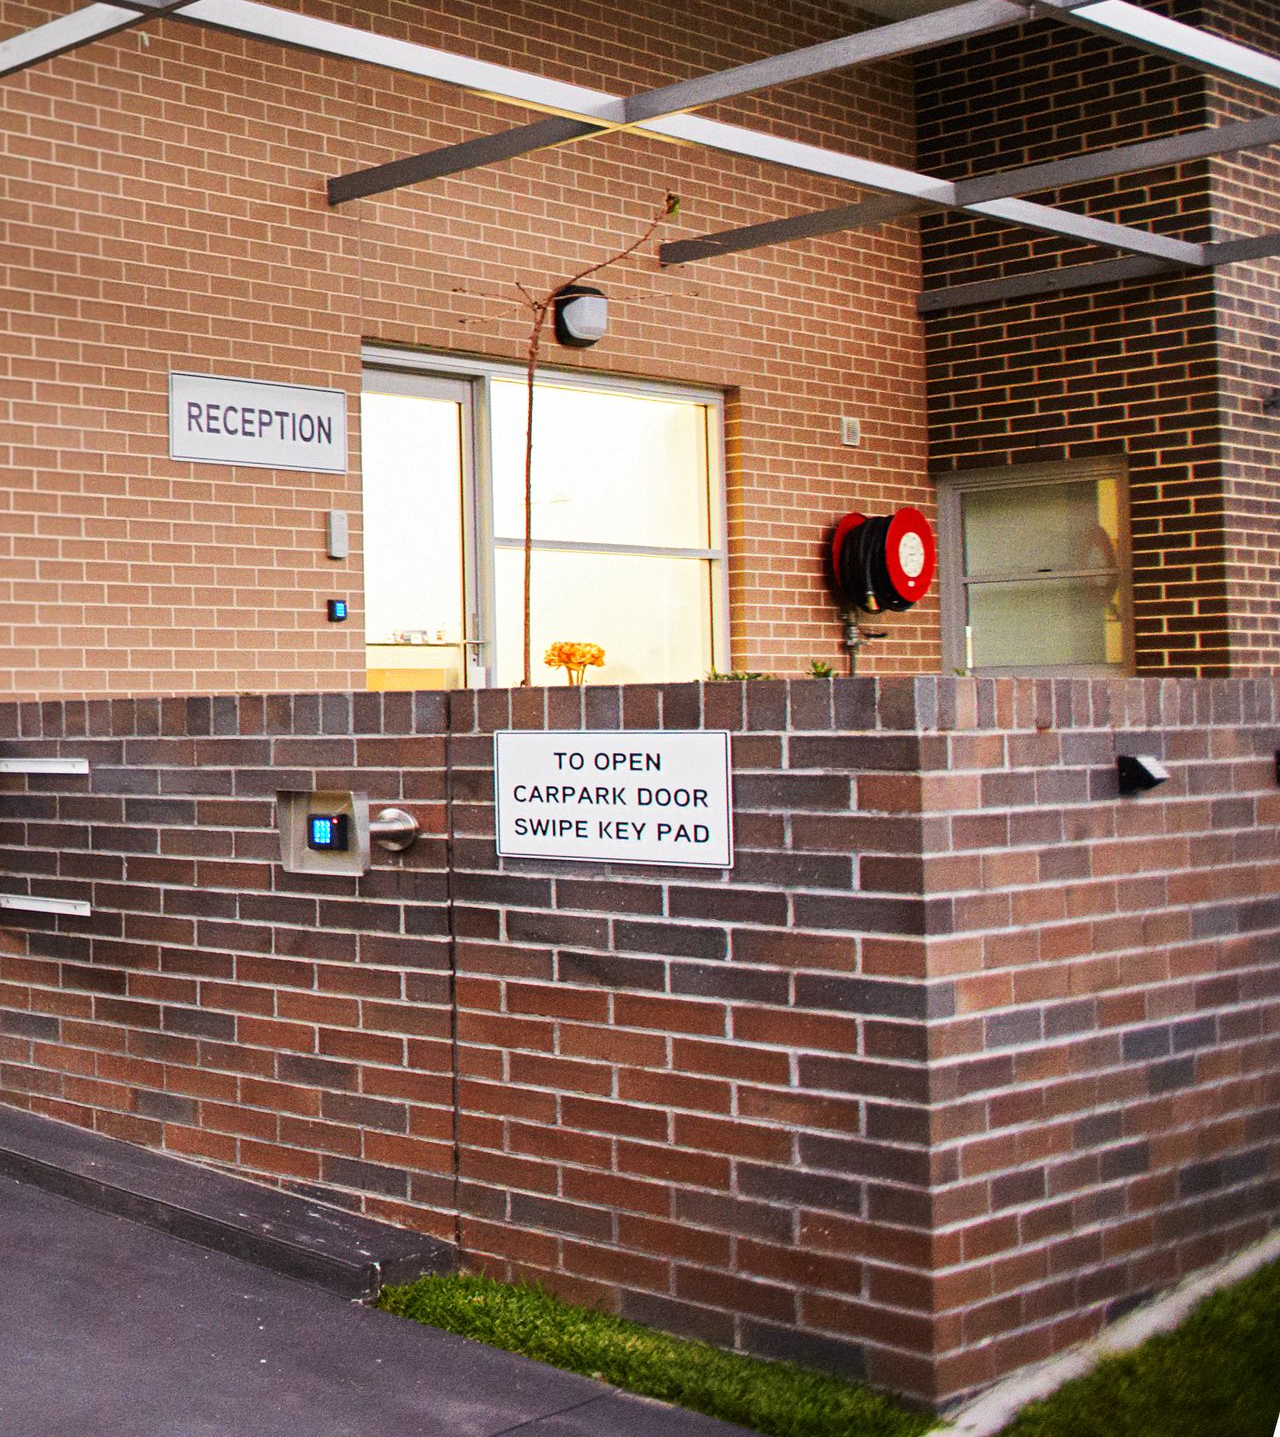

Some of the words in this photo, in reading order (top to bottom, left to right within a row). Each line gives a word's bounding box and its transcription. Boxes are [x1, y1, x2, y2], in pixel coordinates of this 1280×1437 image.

[187, 401, 332, 445] RECEPTION
[554, 752, 584, 770] TO
[594, 752, 661, 771] OPEN
[513, 785, 627, 805] CARPARK
[637, 788, 709, 807] DOOR
[514, 818, 588, 838] SWIPE
[598, 820, 646, 840] KEY
[657, 823, 710, 843] PAD
